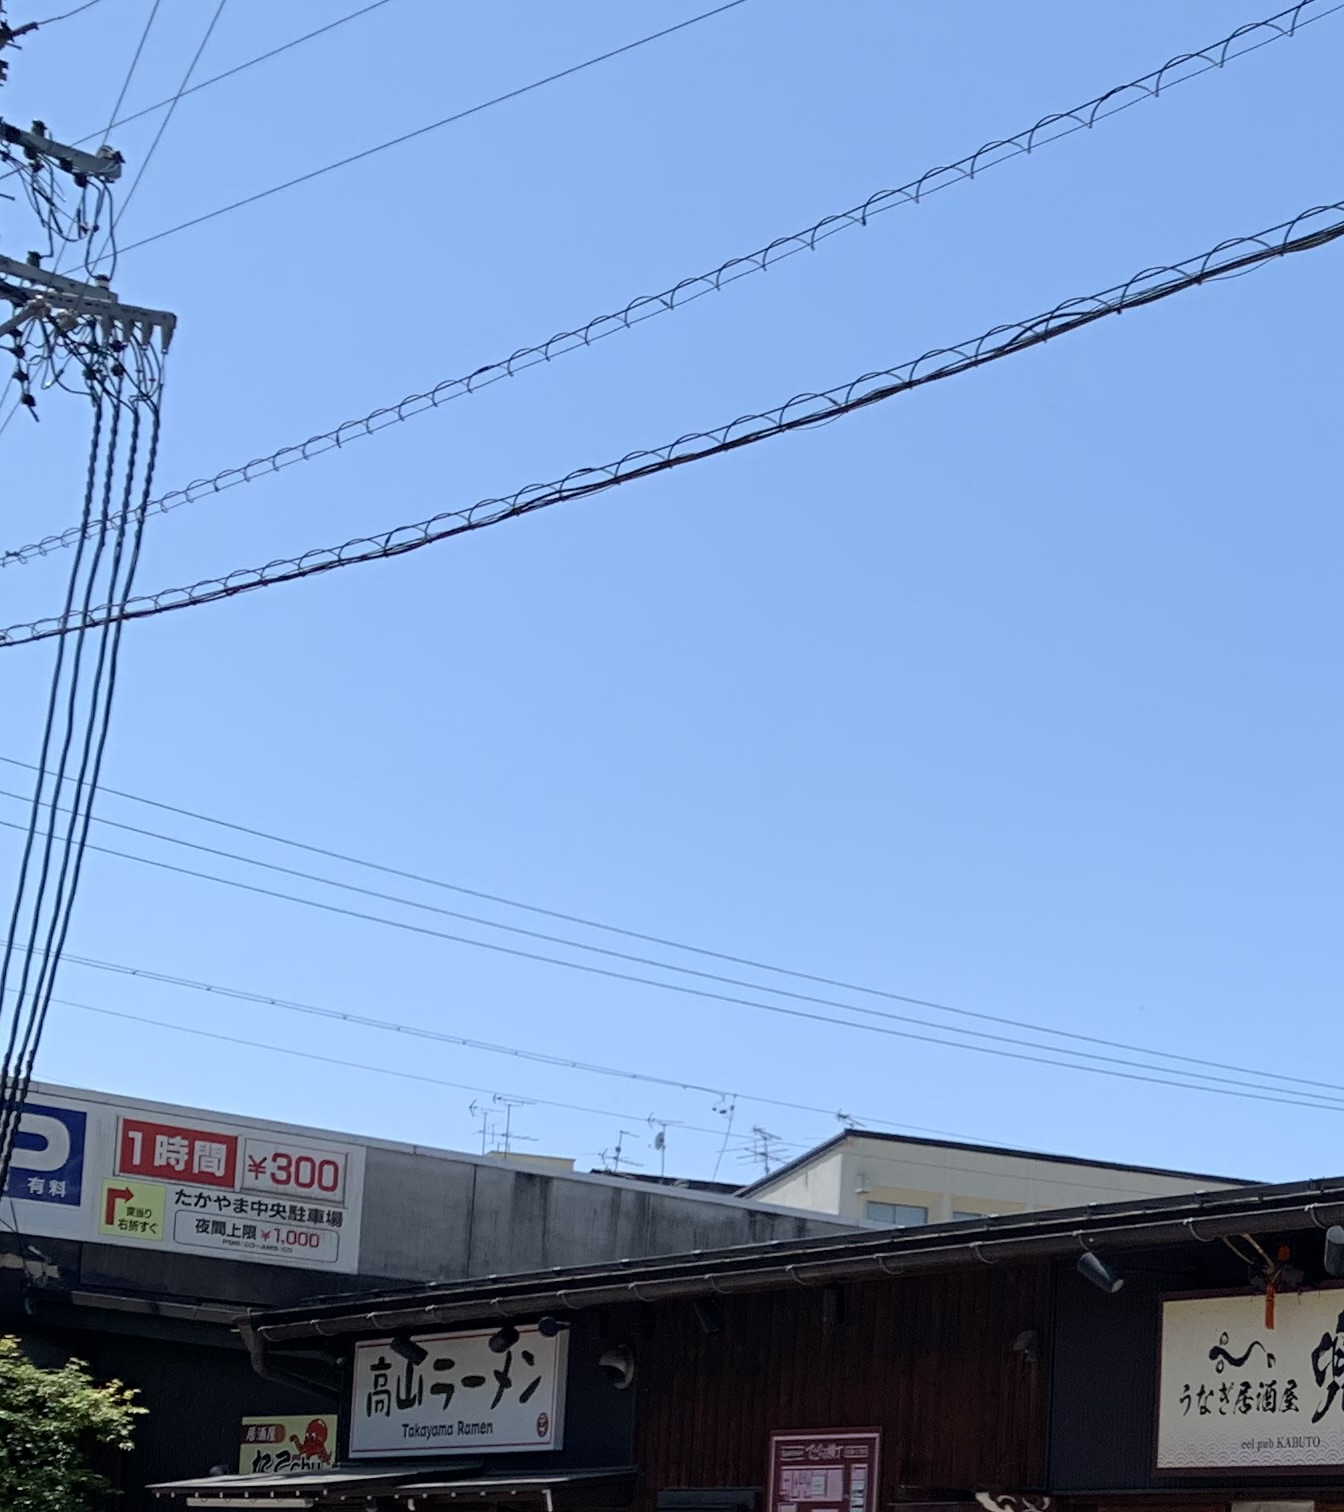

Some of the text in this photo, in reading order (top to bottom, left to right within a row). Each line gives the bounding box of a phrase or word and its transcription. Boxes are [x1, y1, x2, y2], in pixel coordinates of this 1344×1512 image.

[128, 1131, 228, 1178] 1時間
[27, 1177, 66, 1197] 有料
[248, 1152, 339, 1192] ¥300
[175, 1189, 344, 1227] たかやま中央駐車場
[118, 1218, 157, 1235] 右折すぐ
[195, 1218, 257, 1240] 夜間上限
[366, 1350, 542, 1417] 高山ラーメン
[1179, 1379, 1299, 1417] うなぎ居酒屋
[402, 1421, 493, 1440] Takayama Ramen
[1277, 1436, 1321, 1448] KABUTO
